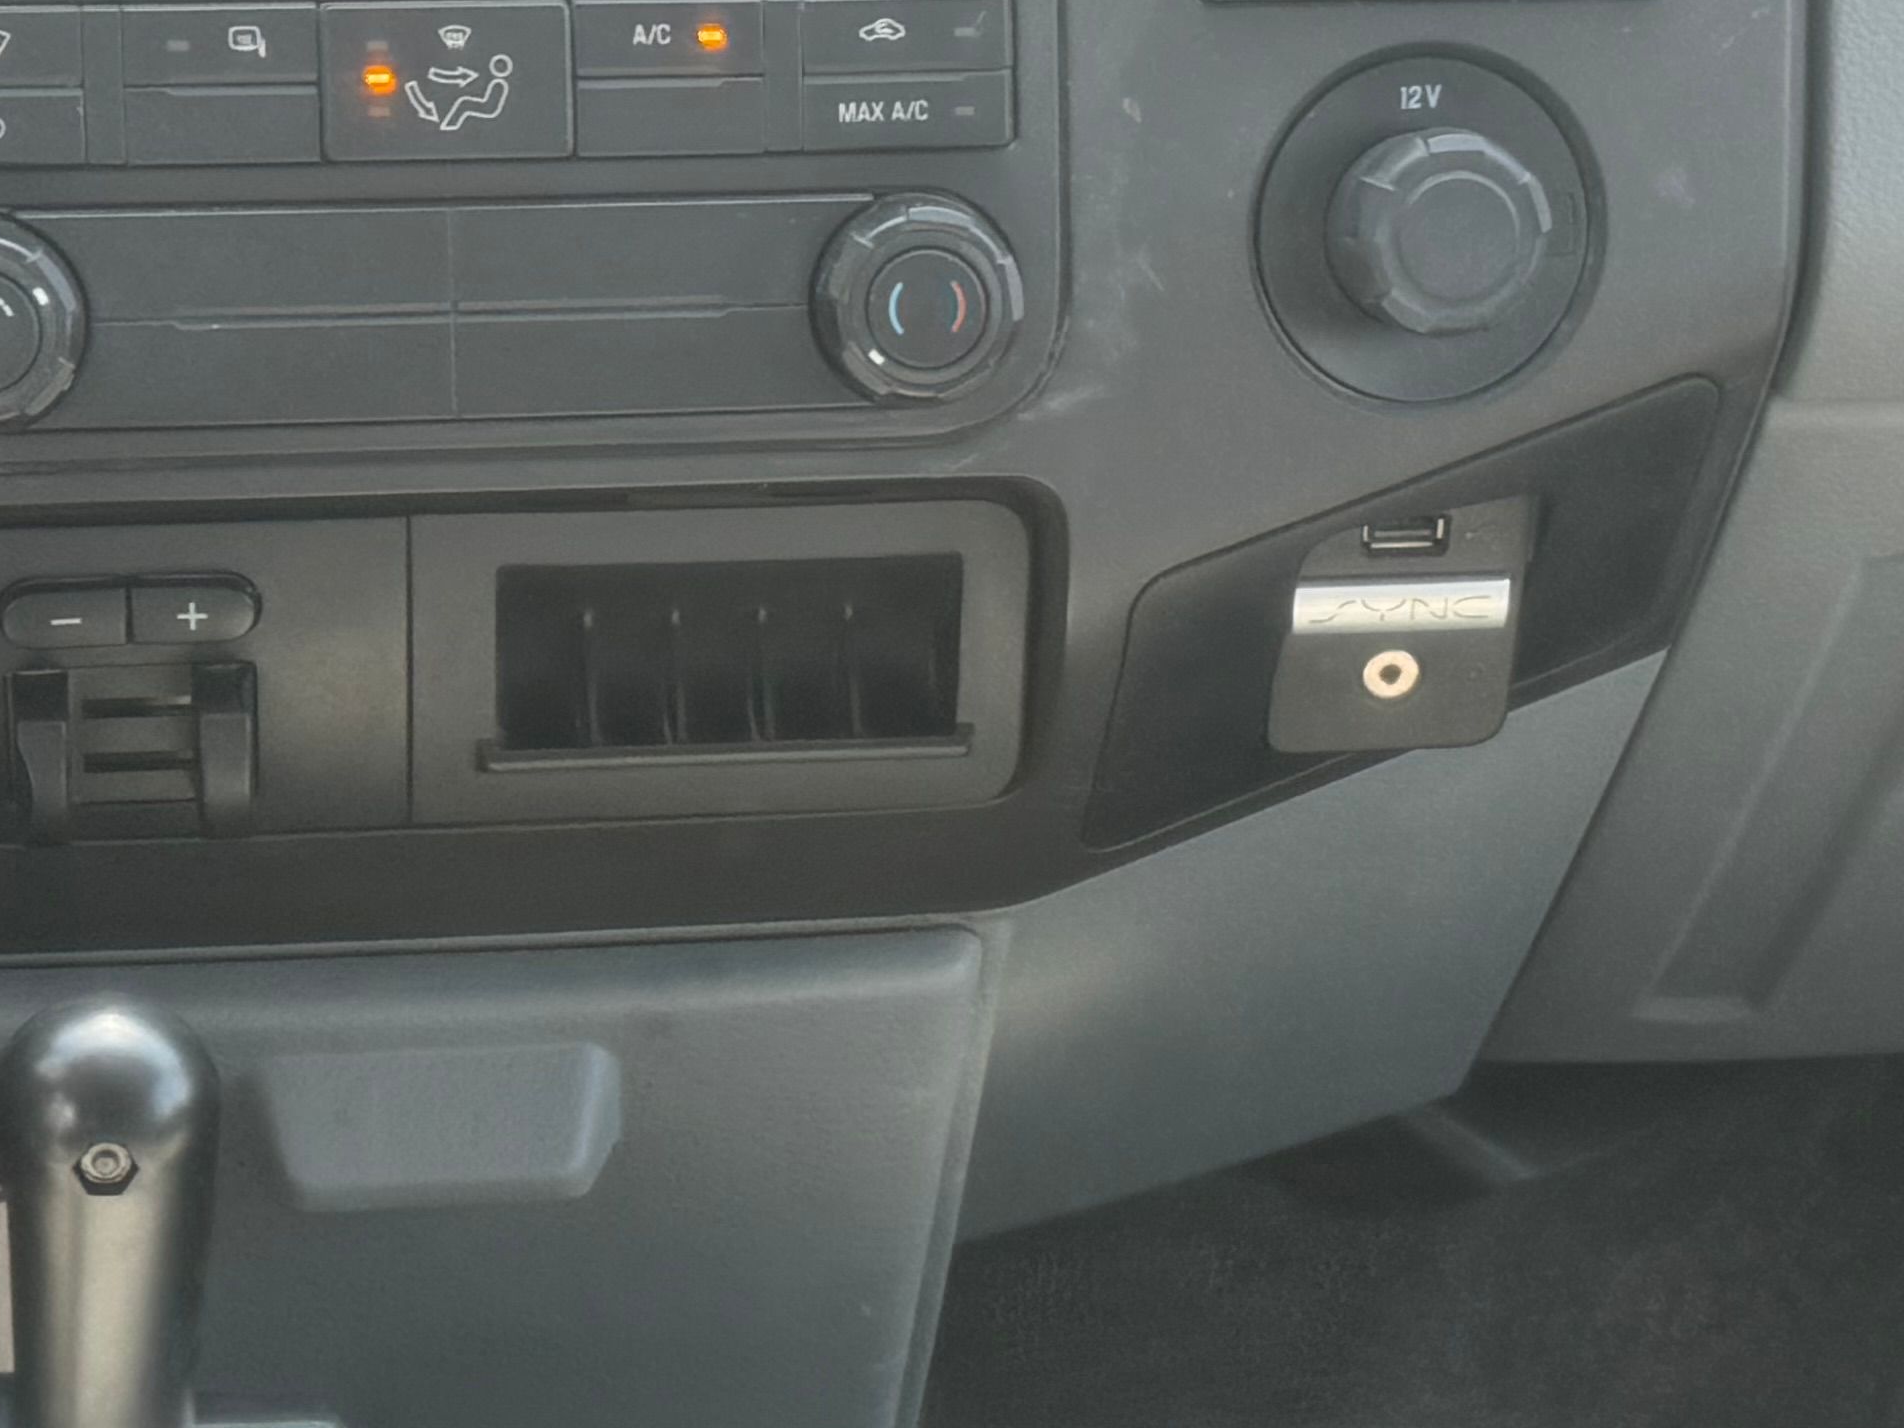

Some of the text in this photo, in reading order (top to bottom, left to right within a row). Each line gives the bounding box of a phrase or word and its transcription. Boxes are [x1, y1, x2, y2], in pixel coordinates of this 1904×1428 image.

[632, 23, 672, 46] A/C
[838, 98, 930, 124] MAX A/C
[1308, 595, 1492, 624] SYNC
